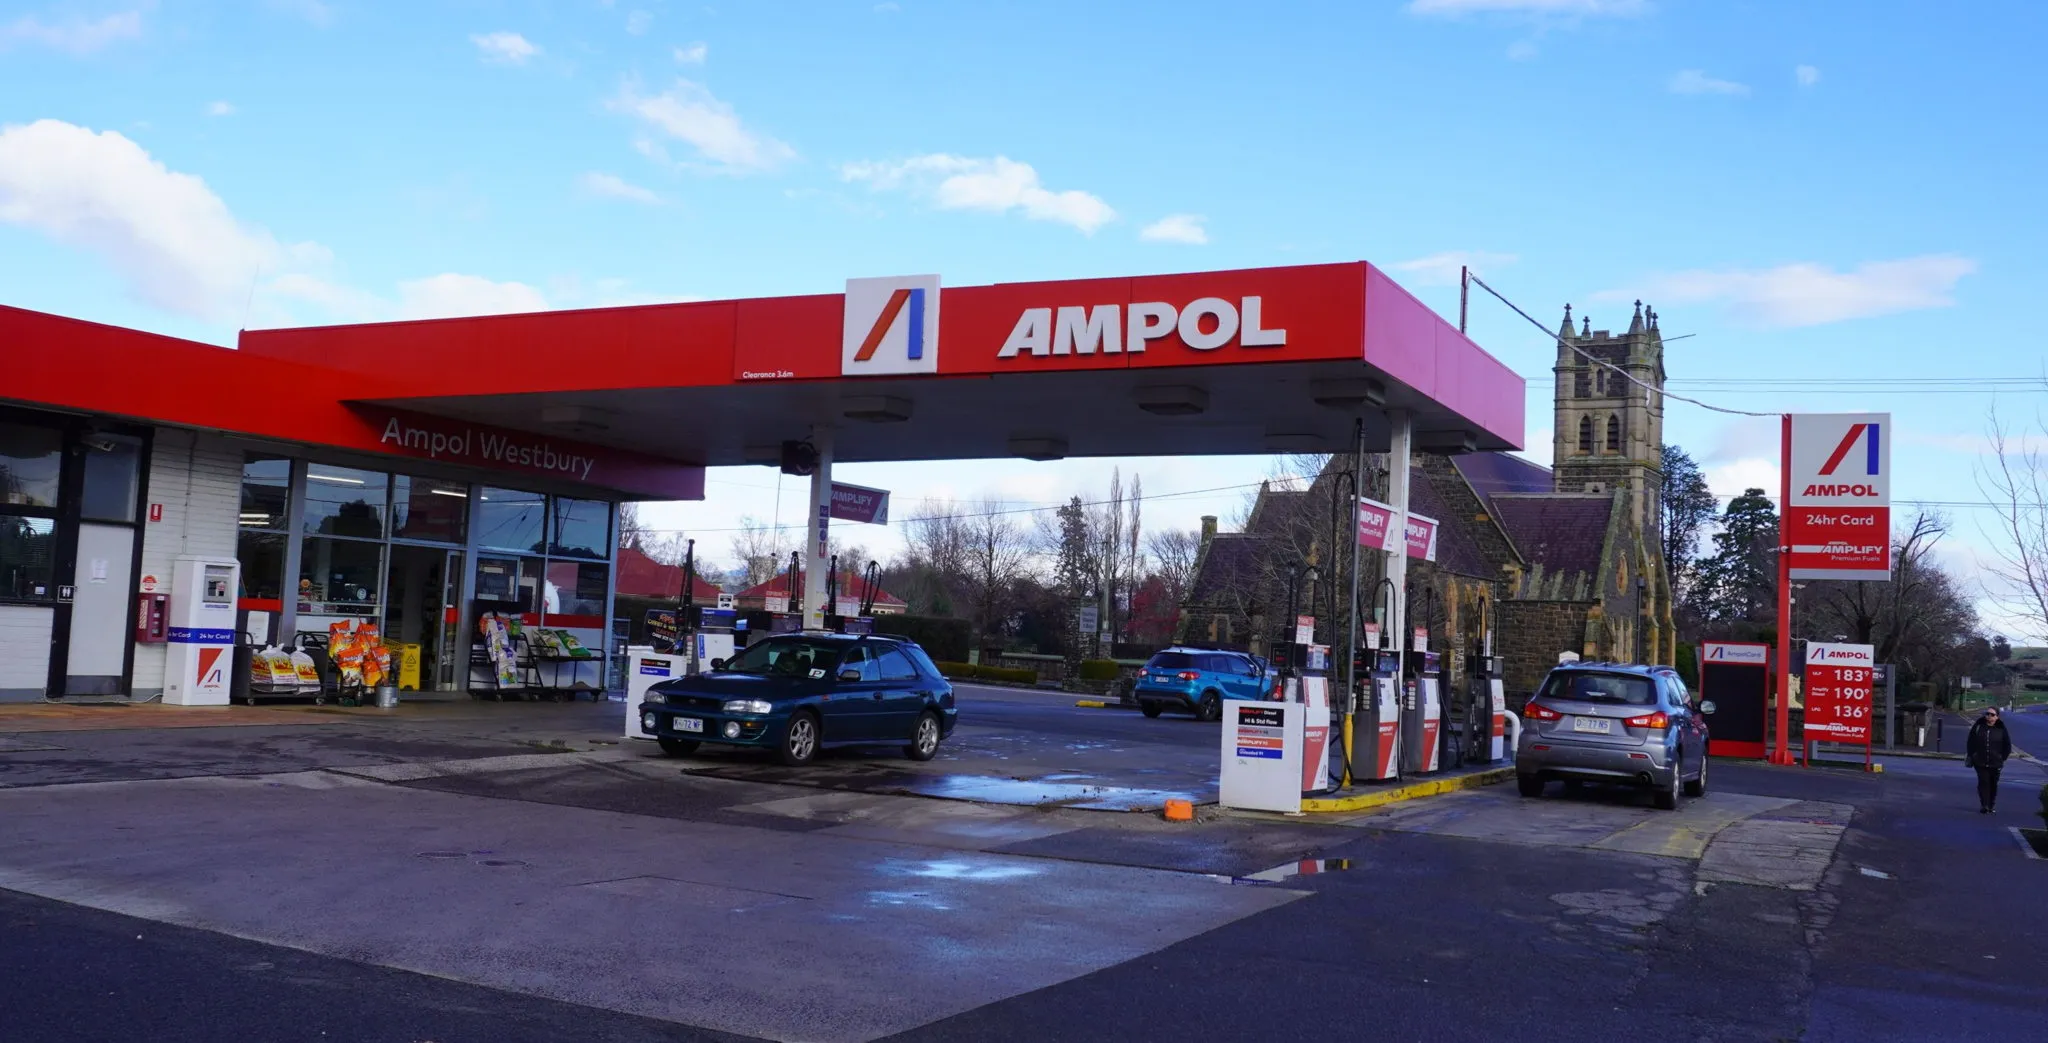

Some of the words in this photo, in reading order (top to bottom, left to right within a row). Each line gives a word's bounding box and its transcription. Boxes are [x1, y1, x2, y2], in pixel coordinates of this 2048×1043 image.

[996, 296, 1287, 357] AMPOL
[381, 416, 471, 458] Ampol
[480, 432, 595, 481] Westbury
[1802, 484, 1879, 497] AMPOL
[832, 490, 873, 505] AMPLIFY
[1361, 510, 1385, 527] MPLIFY
[1806, 514, 1836, 526] 24hr
[1840, 514, 1875, 526] Card
[1823, 545, 1883, 555] AMPLIFY
[1828, 651, 1870, 660] AMPOL
[1825, 725, 1866, 734] AMPLIFY
